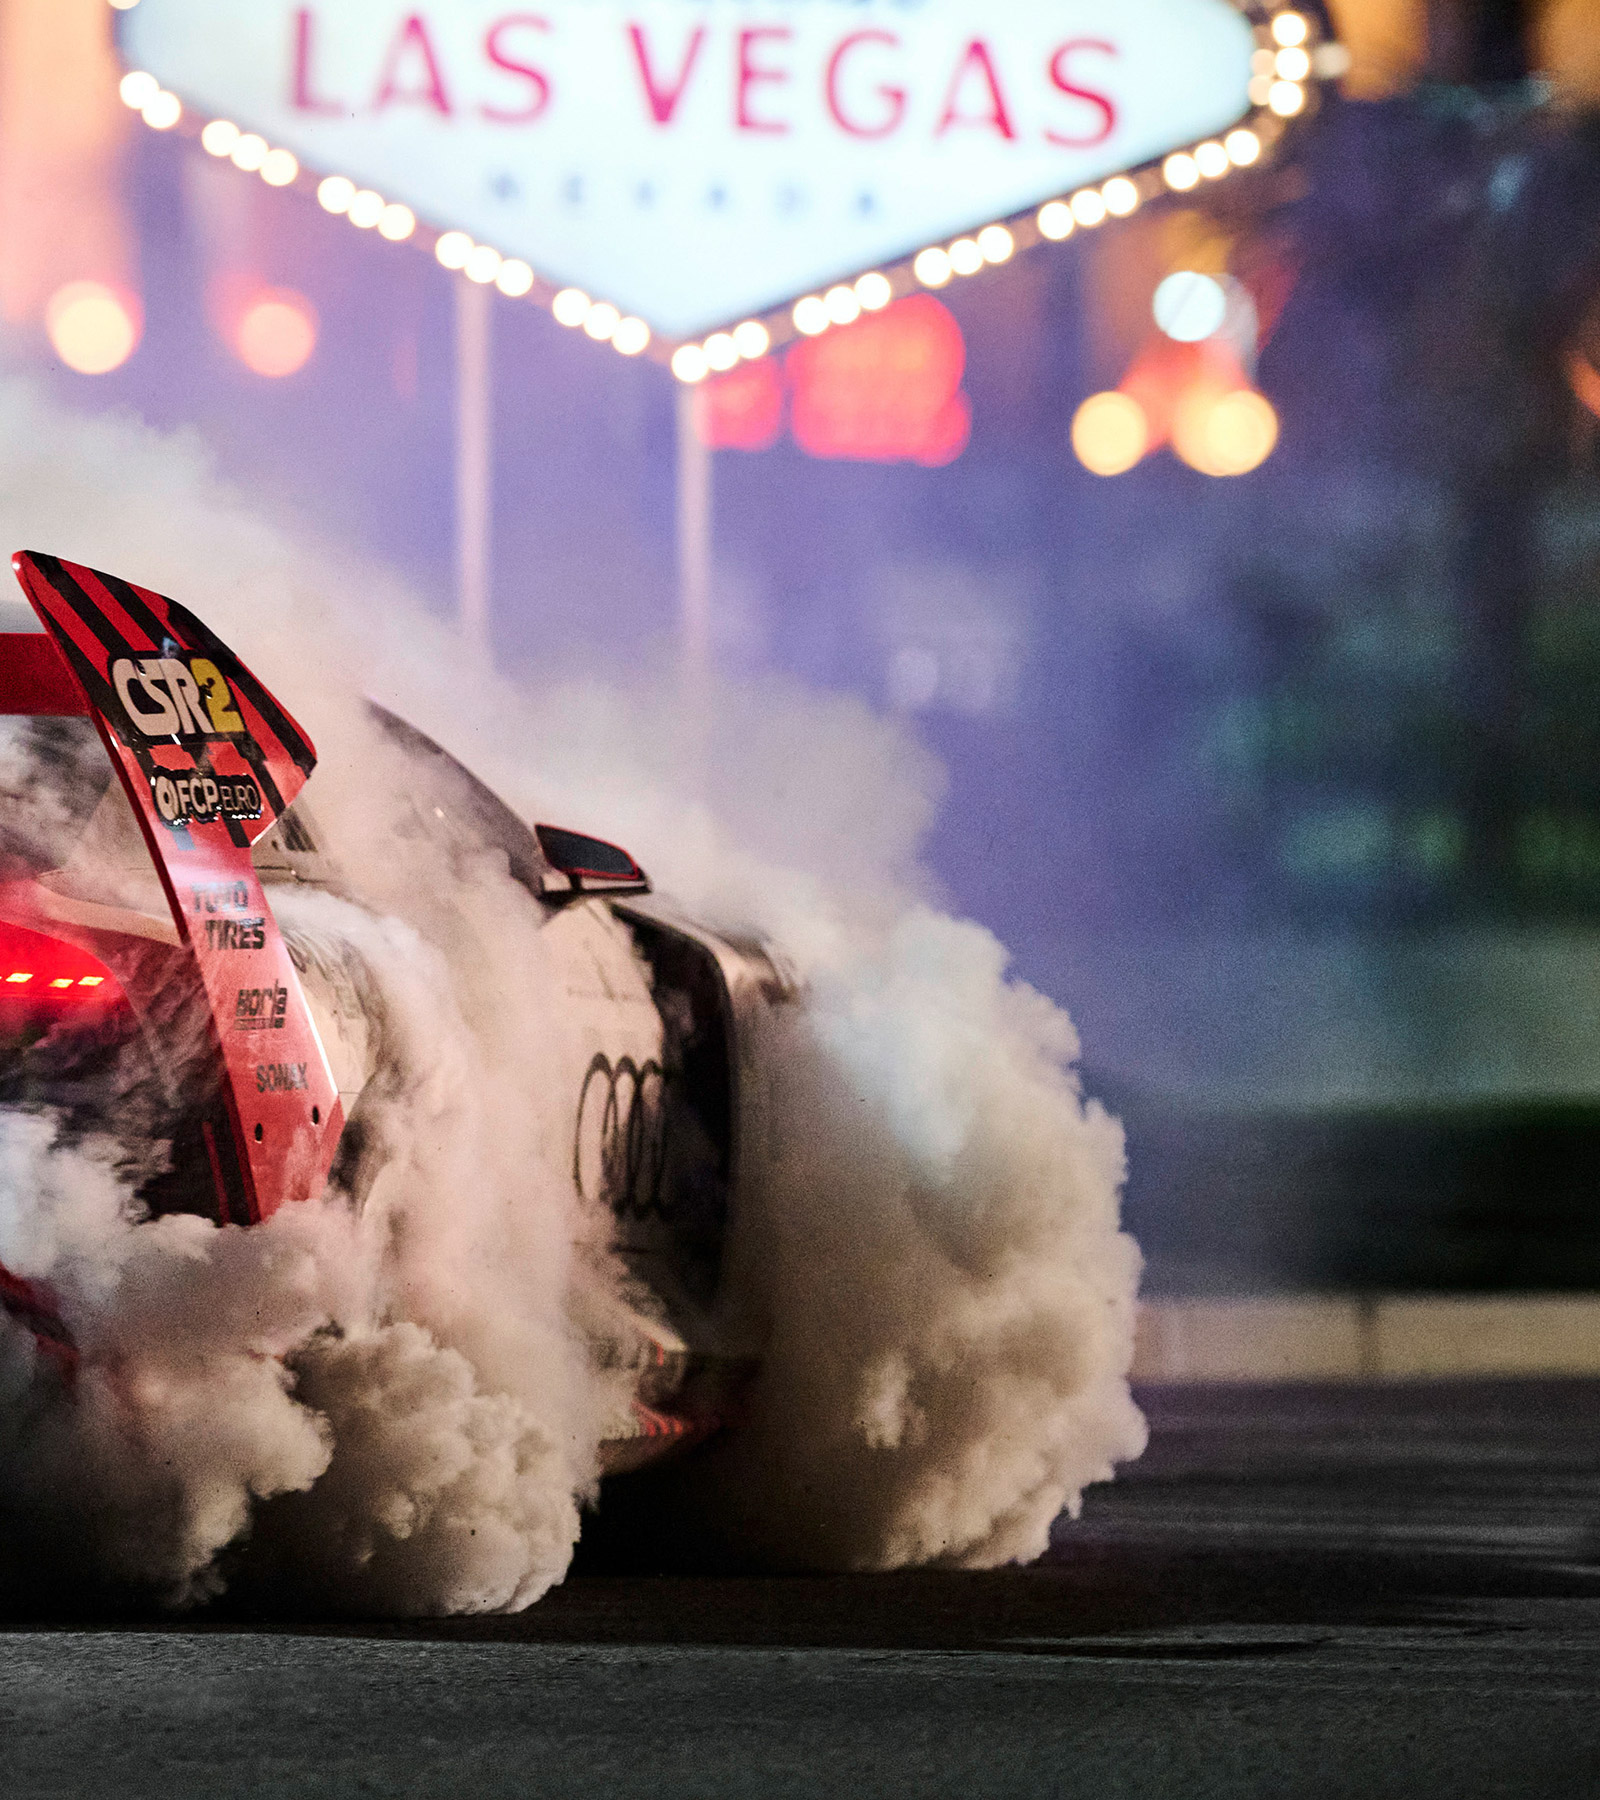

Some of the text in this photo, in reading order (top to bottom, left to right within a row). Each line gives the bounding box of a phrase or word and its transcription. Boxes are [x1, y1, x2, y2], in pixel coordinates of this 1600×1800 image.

[288, 7, 1120, 150] LAS VEGAS
[112, 657, 246, 736] CSR2
[176, 778, 259, 814] FCP EURO
[206, 918, 265, 950] TIRES
